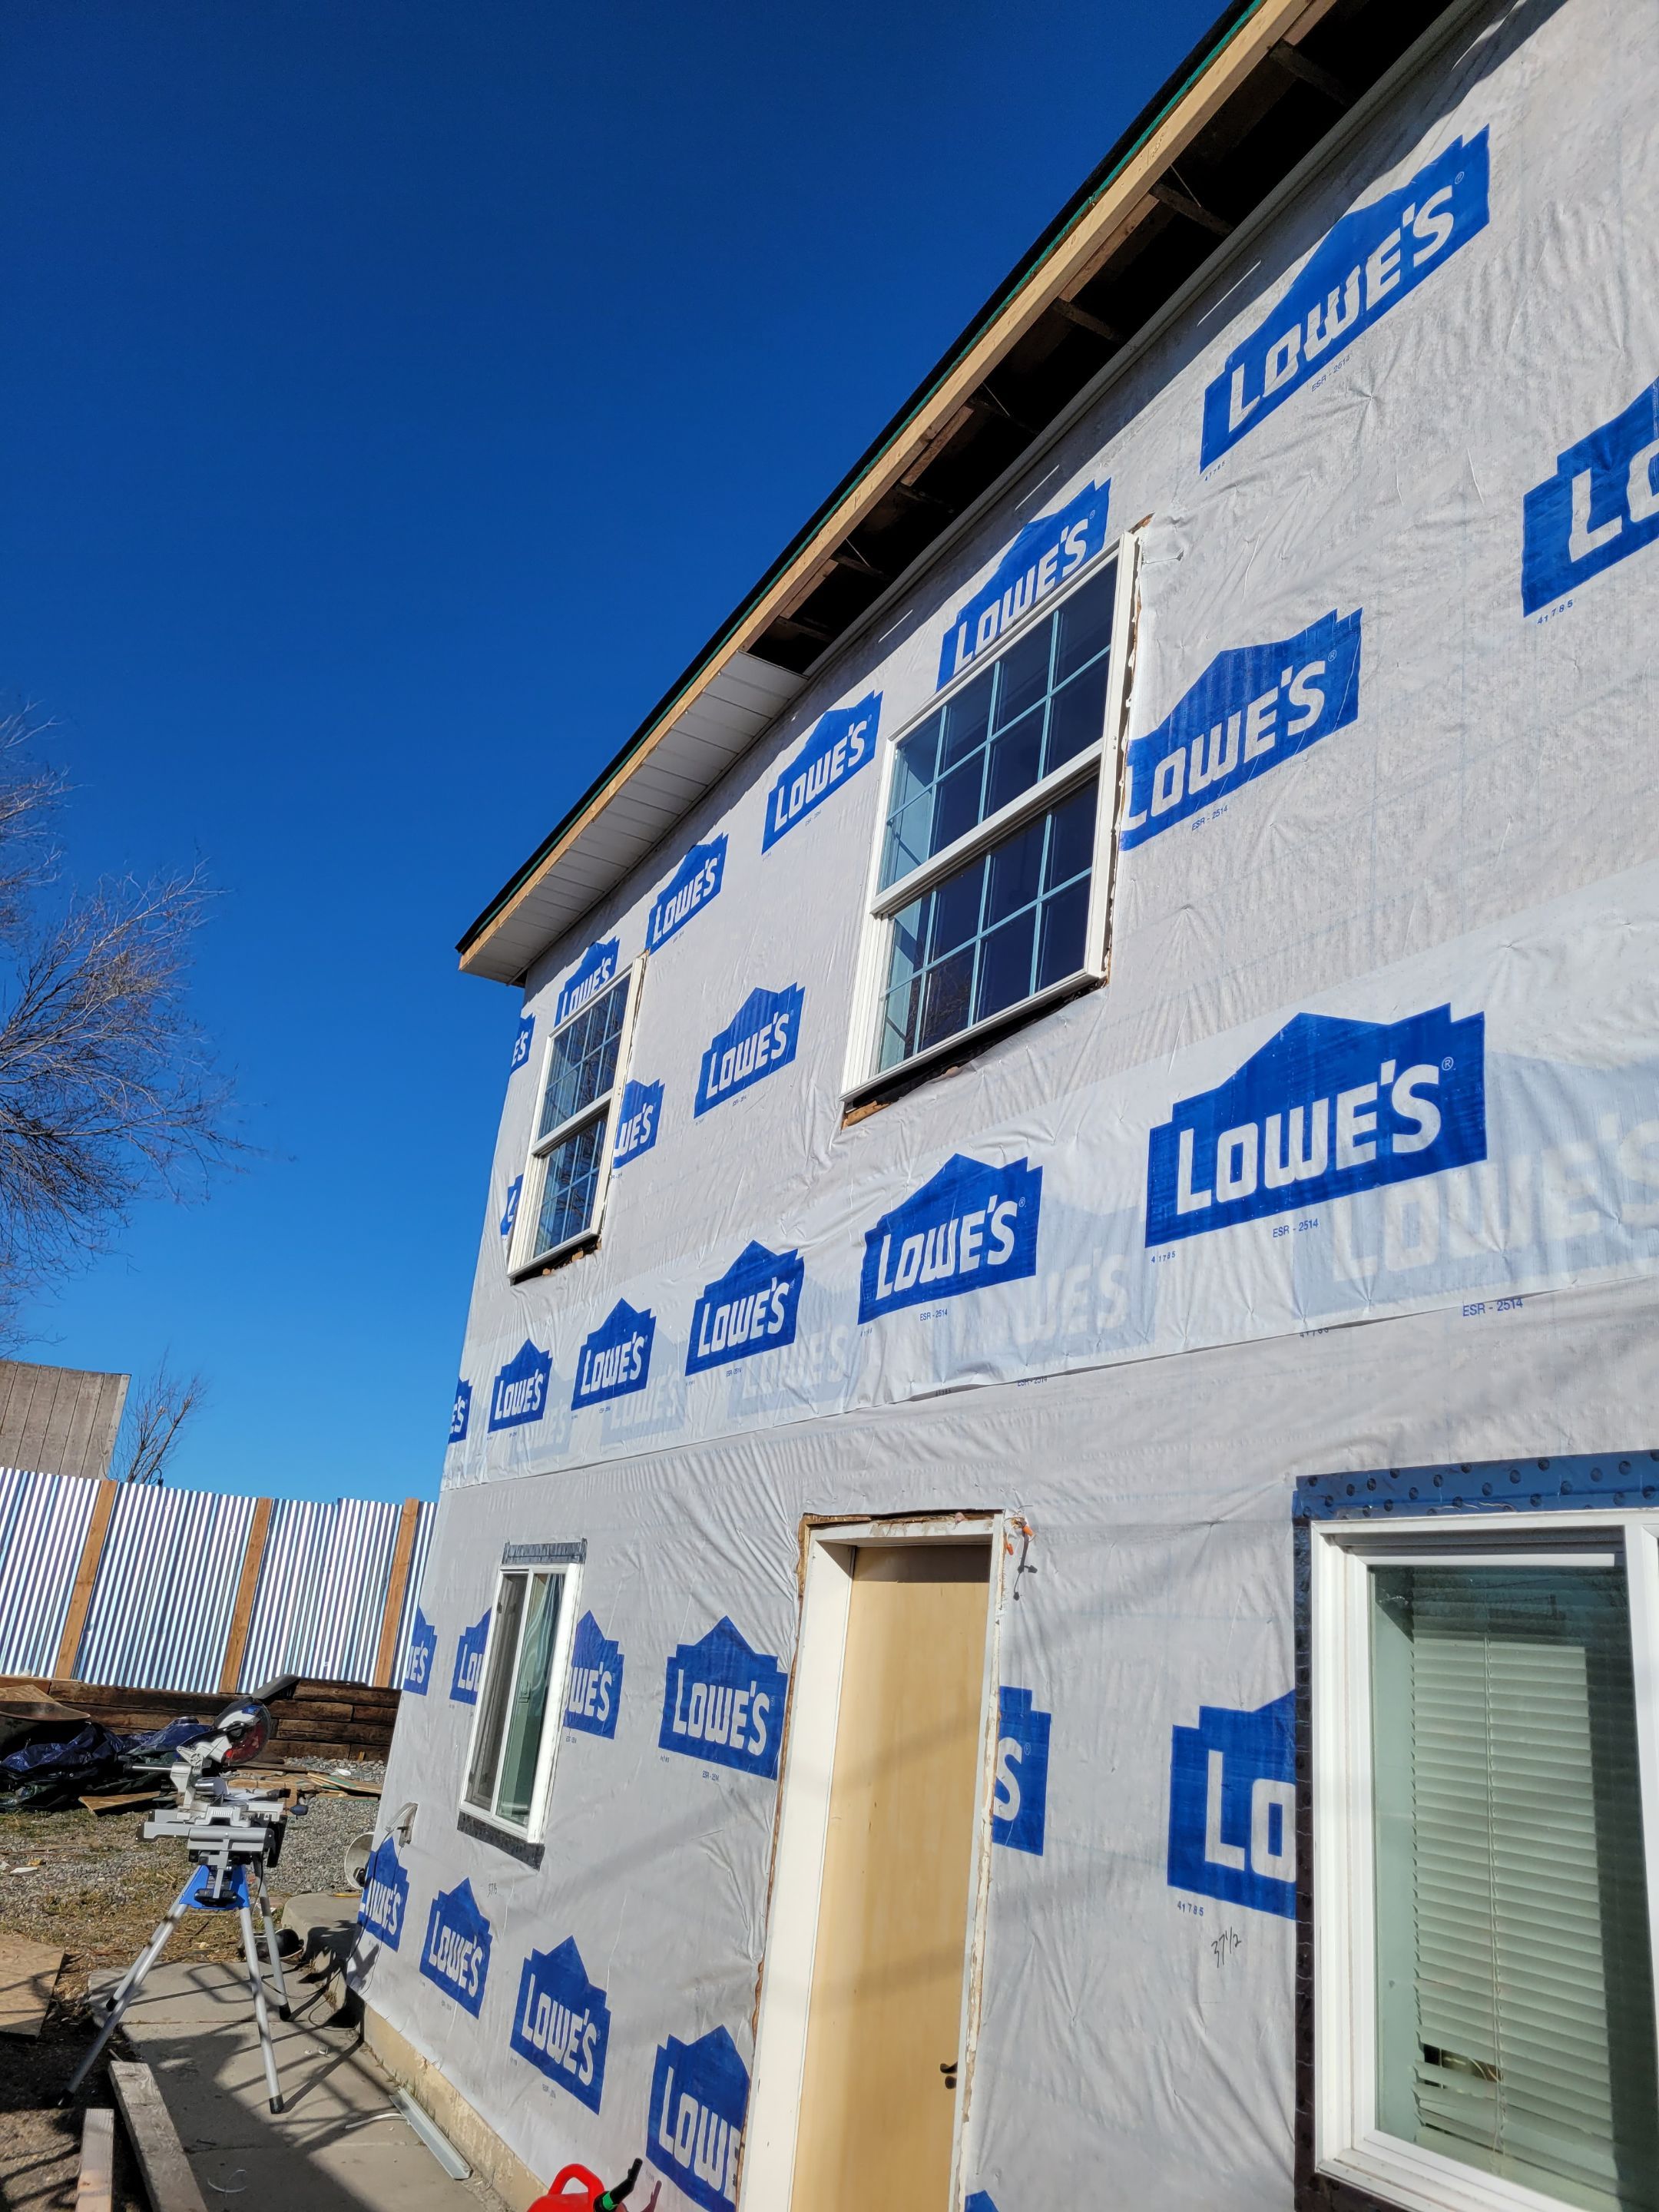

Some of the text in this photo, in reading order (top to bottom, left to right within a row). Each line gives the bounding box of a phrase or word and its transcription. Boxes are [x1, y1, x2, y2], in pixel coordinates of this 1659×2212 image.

[1228, 185, 1455, 432] LOWE'S
[1312, 374, 1326, 392] ESR
[953, 518, 1088, 675] LOWE'S
[1537, 599, 1573, 625] 41785
[773, 719, 868, 832] LOWE'S
[1121, 660, 1326, 831] LOWE'S
[1191, 816, 1205, 832] ESR
[1212, 804, 1228, 820] 2514
[652, 856, 718, 944] LOWE'S
[560, 957, 611, 1024] LOWE'S
[706, 1011, 790, 1097] LOWE'S
[1177, 1060, 1442, 1214] LOWE'S
[876, 1195, 1018, 1300] LOWE'S
[1273, 1224, 1290, 1238] ESR
[1298, 1218, 1319, 1232] 2514
[697, 1277, 790, 1357] LOWE'S
[919, 1311, 931, 1322] ESR
[935, 1308, 948, 1318] 2514
[1462, 1302, 1486, 1317] ESR
[1496, 1297, 1524, 1312] 2514
[494, 1368, 544, 1420] LOWE'S
[580, 1331, 644, 1396] LOWE'S
[567, 1661, 612, 1721] WE'S
[672, 1668, 770, 1757] LOWE'S
[1177, 1900, 1204, 1917] 41785
[428, 1911, 483, 1998] LOWE'S
[521, 1973, 597, 2086] LOWE'S
